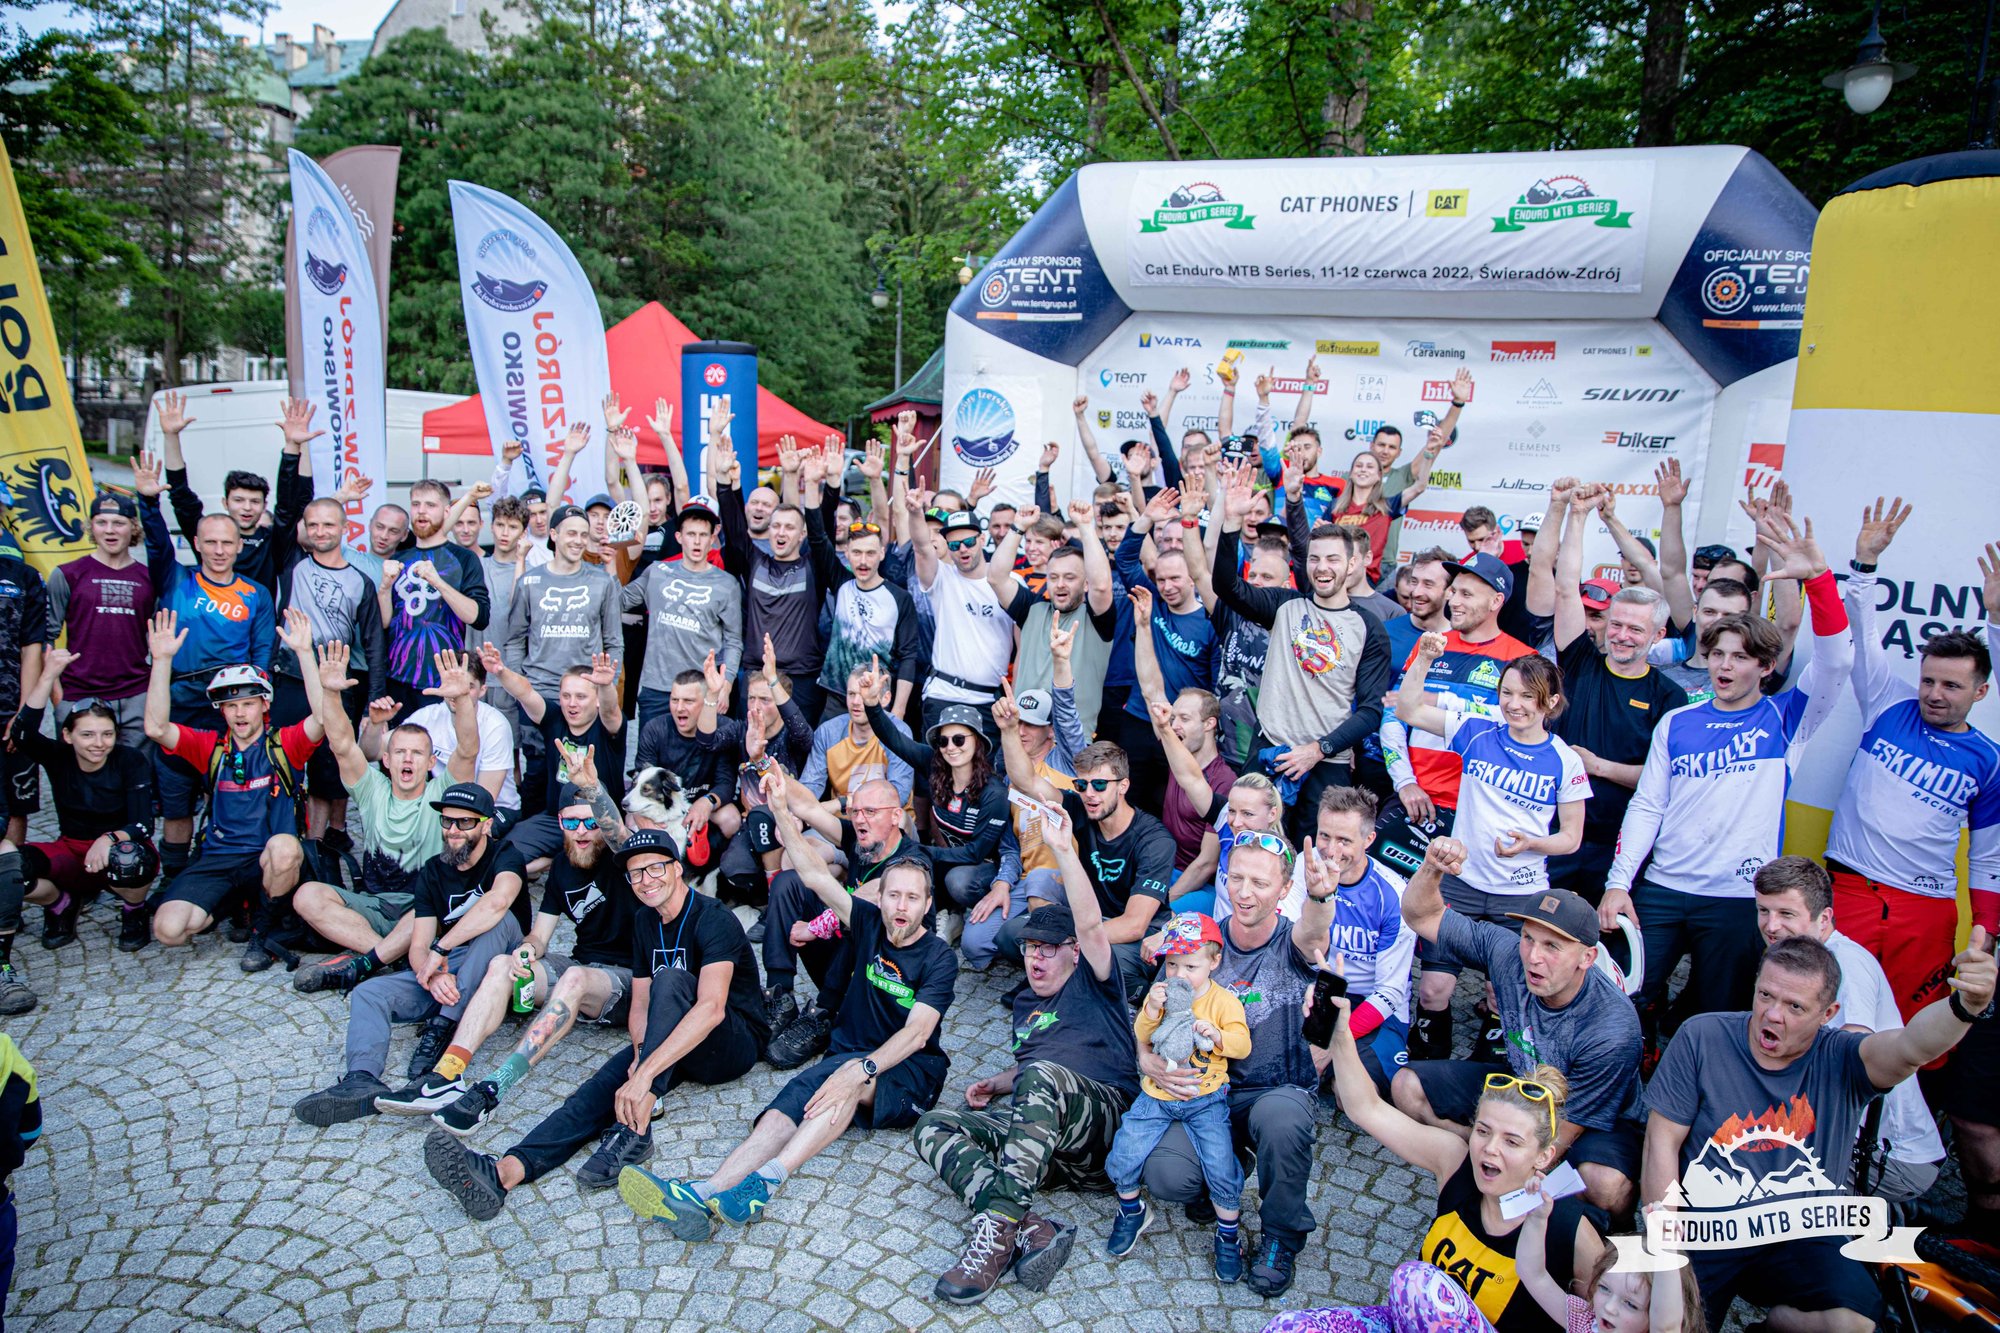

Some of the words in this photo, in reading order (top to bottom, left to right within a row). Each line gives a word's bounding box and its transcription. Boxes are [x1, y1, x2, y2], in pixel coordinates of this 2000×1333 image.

[1280, 195, 1315, 213] CAT
[1320, 195, 1399, 213] PHONES
[1434, 195, 1460, 210] CAT
[1158, 209, 1188, 223] ENDURO
[1190, 208, 1208, 221] MTB
[1210, 206, 1238, 218] SERIES
[1514, 206, 1549, 221] ENDURO
[1553, 204, 1572, 218] MTB
[1577, 201, 1611, 214] SERIES
[1032, 256, 1082, 267] SPONSOR
[1704, 249, 1783, 262] OFICJALNY
[1004, 268, 1082, 286] TENT
[1145, 264, 1169, 276] Cat
[1173, 264, 1224, 277] Enduro
[1228, 265, 1260, 277] MTB
[1265, 265, 1315, 279] Series,
[1321, 266, 1359, 279] 11-12
[1364, 269, 1428, 279] czerwca
[1432, 266, 1474, 280] 2022,
[1479, 263, 1622, 283] Świeradów-Zdrój
[1011, 300, 1077, 310] www.tentgrupa.pl
[1155, 336, 1202, 347] VARTA
[1413, 347, 1466, 360] Caravaning
[1359, 376, 1384, 386] SPA
[1582, 387, 1681, 402] SILVINI
[1116, 411, 1150, 420] DOLNY
[1116, 419, 1147, 430] ŚLĄSK
[1229, 441, 1242, 451] 26
[1508, 442, 1561, 452] ELEMENTS
[1491, 477, 1545, 491] Julbo
[1600, 483, 1660, 496] MAXXI
[194, 597, 244, 618] FOOG
[662, 612, 701, 629] AZKARRA
[543, 625, 590, 634] AZKARRA
[1504, 794, 1544, 812] RACING
[1911, 790, 1959, 817] RACING
[1142, 879, 1167, 893] FOX
[889, 984, 910, 998] SERIES
[1431, 1238, 1496, 1298] CAT
